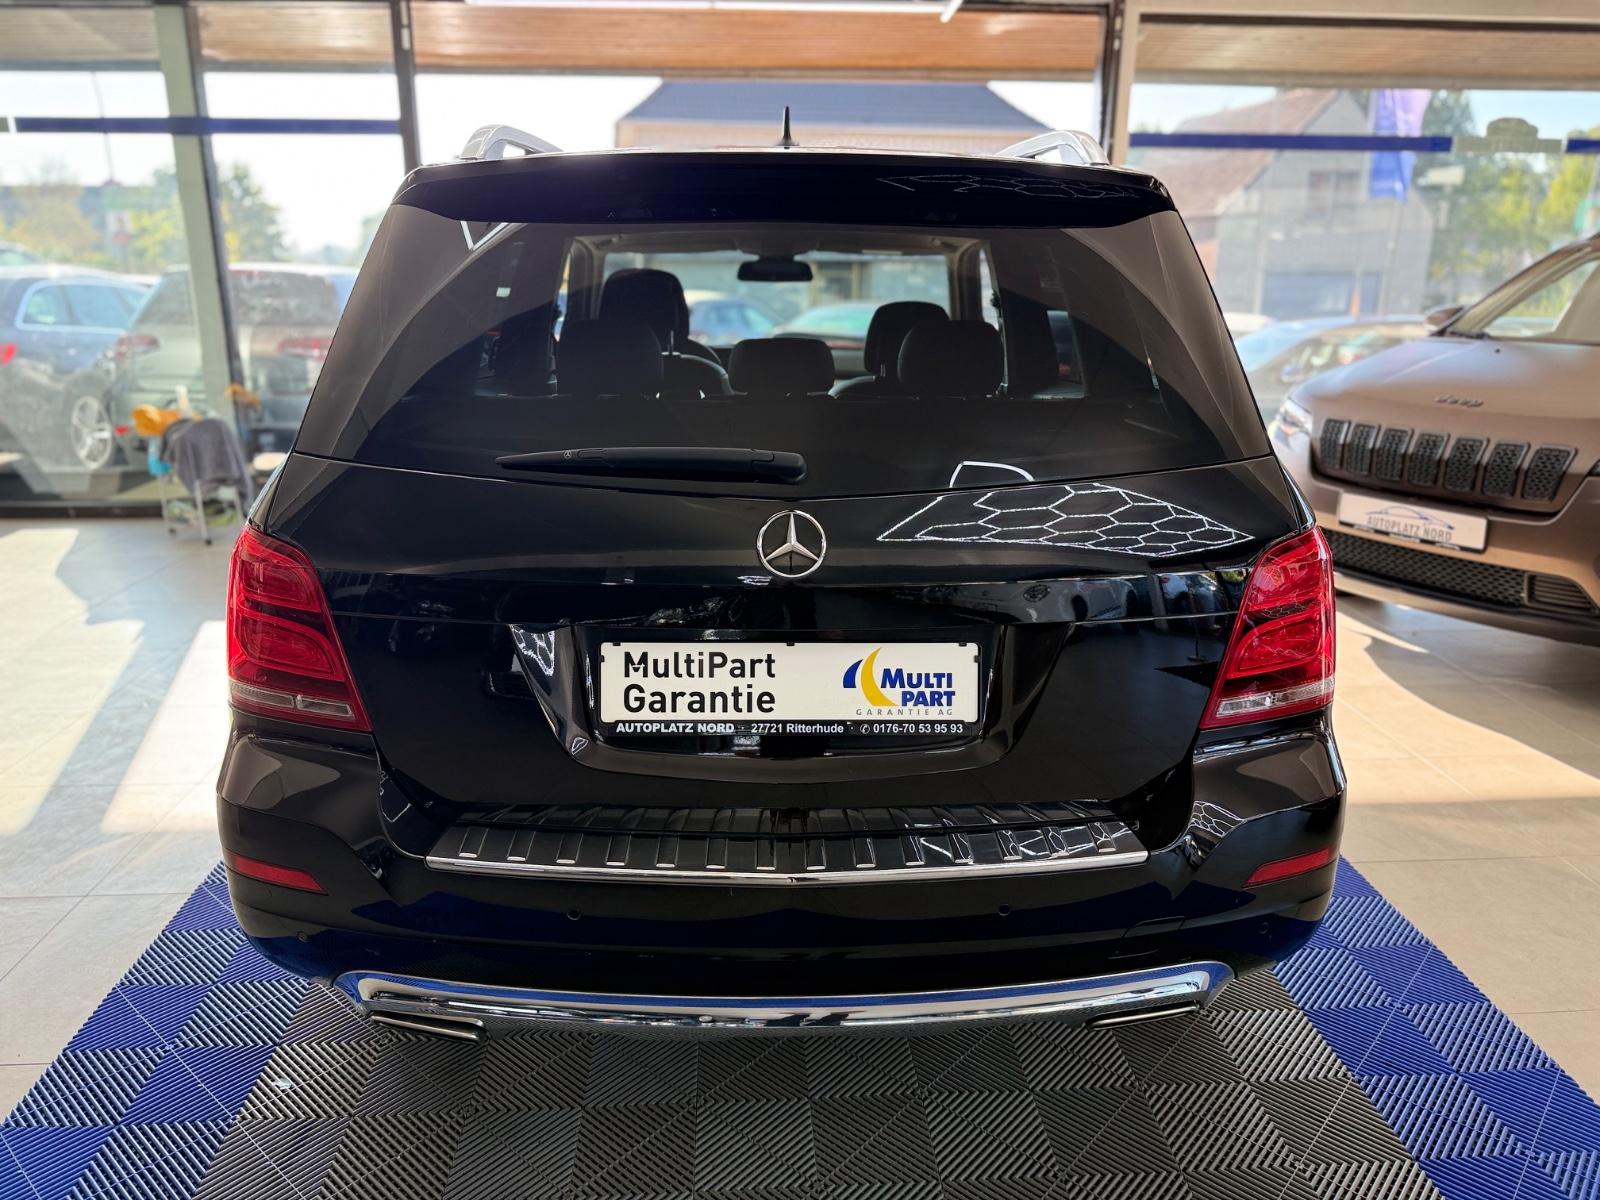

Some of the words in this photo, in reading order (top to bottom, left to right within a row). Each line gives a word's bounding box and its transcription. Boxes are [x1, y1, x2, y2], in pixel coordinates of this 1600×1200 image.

[1366, 515, 1421, 536] AUTOPLATZ
[1423, 526, 1453, 543] NORD
[624, 651, 776, 678] MultiPart
[880, 668, 953, 689] MULTI
[623, 683, 776, 713] Garantie
[901, 690, 956, 707] PART
[856, 708, 930, 716] GARANTIE
[938, 708, 954, 716] AG
[616, 723, 694, 733] AUTOPLATZ
[698, 723, 735, 733] NORD
[751, 723, 783, 733] 27721
[786, 723, 844, 734] Ritterhude
[873, 723, 916, 734] 0176-70
[918, 723, 932, 734] 53
[934, 723, 948, 734] 95
[950, 723, 964, 734] 93
